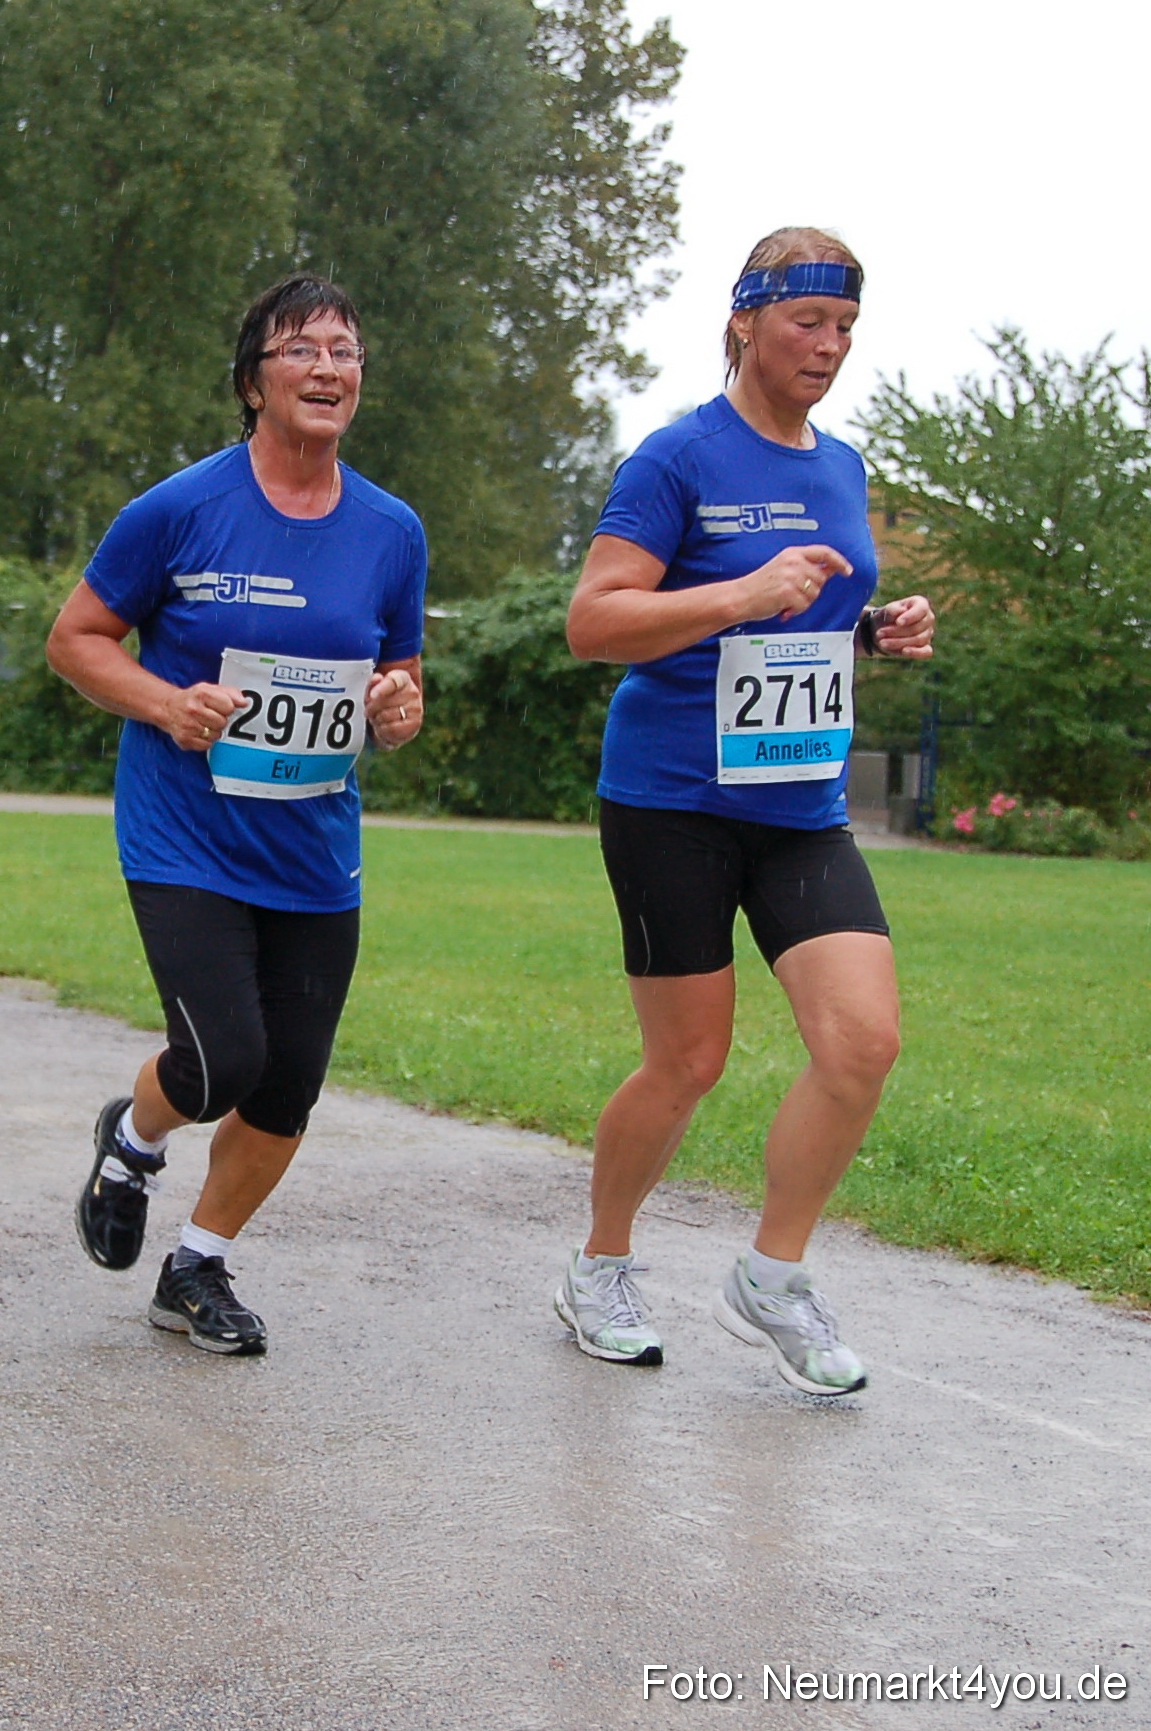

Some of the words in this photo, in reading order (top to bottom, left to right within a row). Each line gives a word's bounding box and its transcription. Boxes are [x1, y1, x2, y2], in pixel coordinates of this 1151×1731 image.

[764, 642, 819, 658] BOCK
[273, 665, 336, 684] BOCK
[734, 672, 843, 728] 2714
[228, 690, 355, 750] 2918
[755, 739, 833, 761] Annelies
[271, 759, 302, 780] Evi
